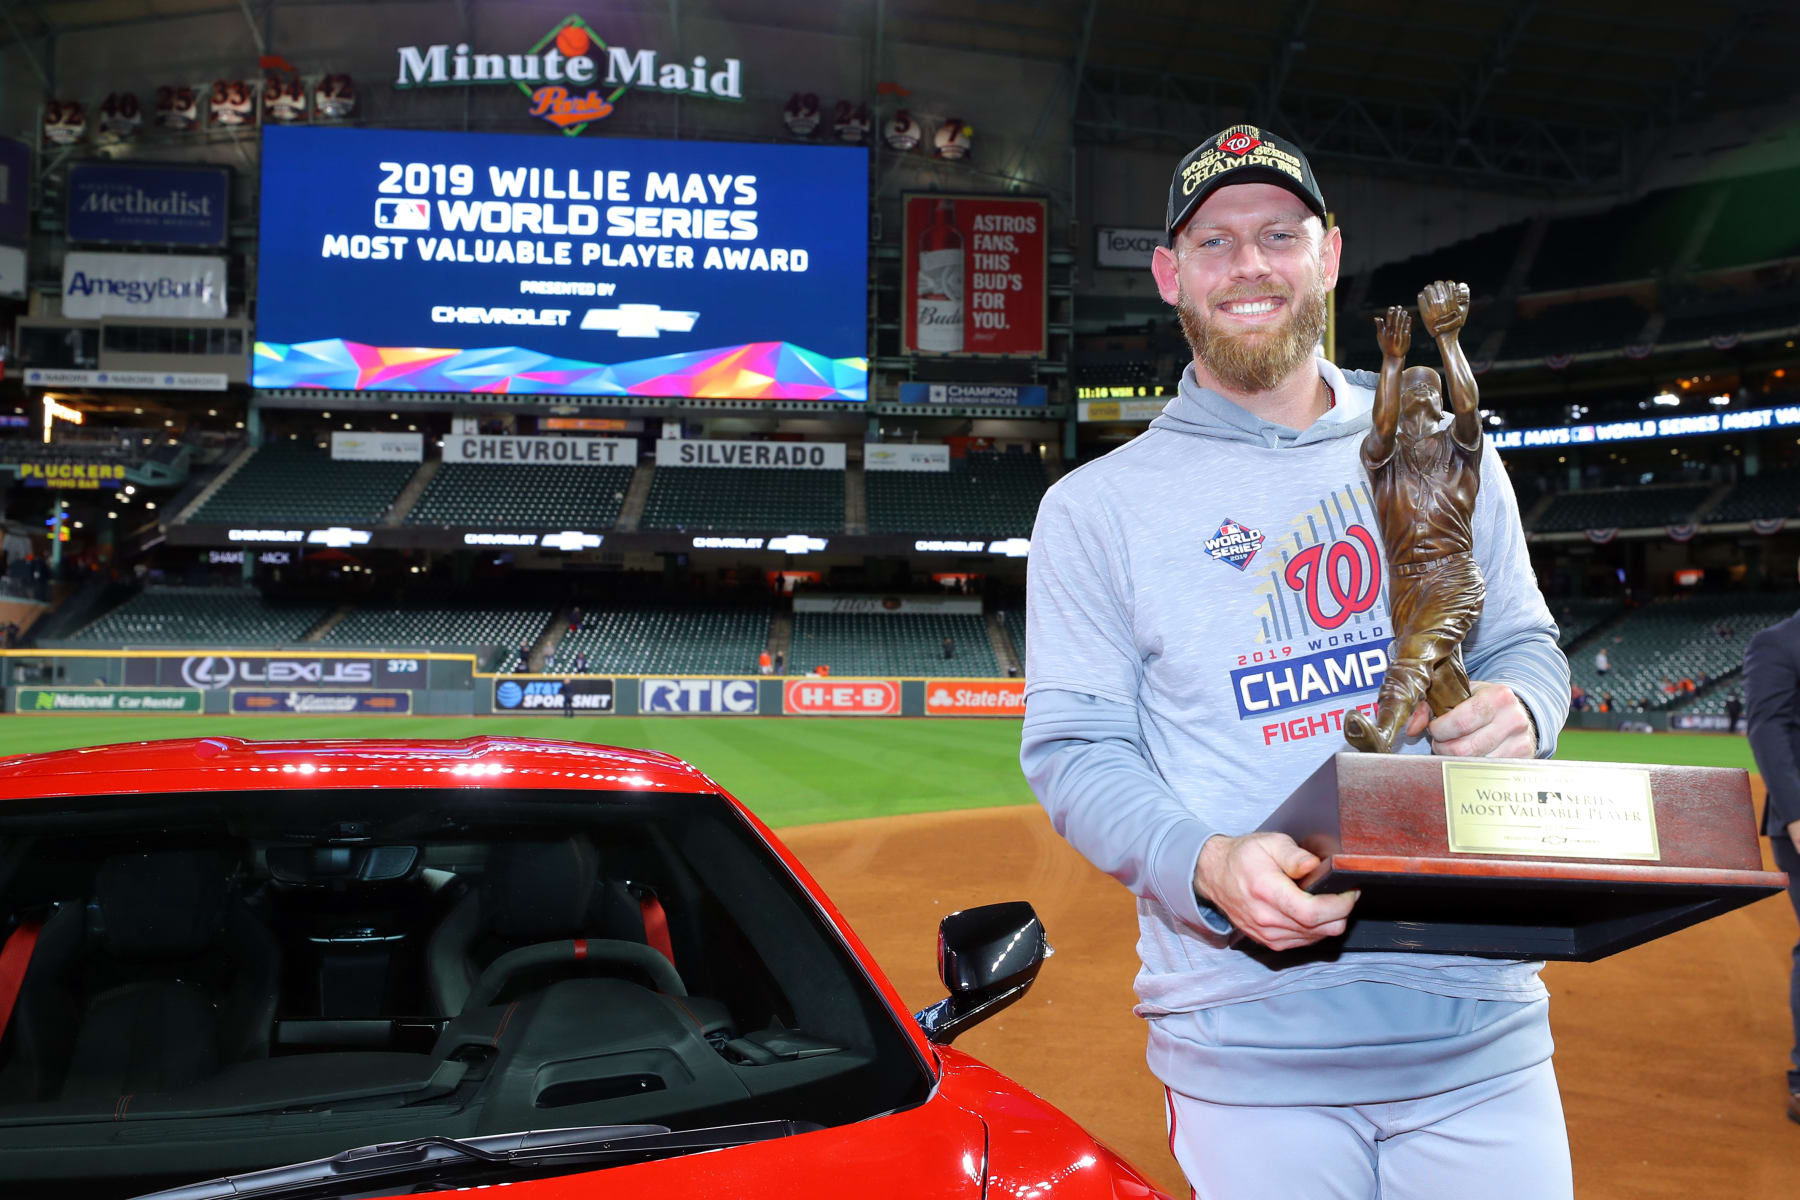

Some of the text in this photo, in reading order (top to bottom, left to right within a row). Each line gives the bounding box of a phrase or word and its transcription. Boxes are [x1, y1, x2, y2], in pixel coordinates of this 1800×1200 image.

[395, 43, 743, 98] Minute Maid
[211, 80, 248, 105] 33
[529, 86, 613, 126] Park
[944, 119, 964, 142] 7
[1181, 145, 1301, 180] WORLD SERIES
[378, 162, 758, 205] 2019 WILLIE MAYS
[1182, 154, 1304, 196] CHAMPIONS
[79, 189, 212, 217] Methodist
[438, 200, 758, 241] WORLD SERIES
[973, 214, 1037, 234] ASTROS
[322, 234, 809, 273] MOST VALUABLE PLAYER AWARD
[973, 234, 1019, 255] FANS,
[973, 254, 1011, 272] THIS
[520, 280, 616, 297] PRESENTED BY
[973, 273, 1023, 291] BUD'S
[973, 292, 1005, 310] FOR
[431, 305, 572, 327] CHEVROLET
[973, 311, 1011, 330] YOU.
[948, 385, 1018, 398] CHAMPION
[1524, 428, 1570, 446] MAYS
[1596, 420, 1657, 440] WORLD
[1658, 415, 1720, 435] SERIES
[1722, 409, 1773, 429] MOST
[461, 439, 619, 462] CHEVROLET
[680, 443, 826, 467] SILVERADO
[21, 463, 126, 479] PLUCKERS
[464, 533, 538, 545] CHEVROLET
[1204, 529, 1261, 550] WORLD
[1211, 540, 1263, 560] SERIES
[1230, 553, 1249, 561] 2019
[1238, 626, 1384, 666] 2019 WORLD
[240, 661, 372, 682] LEXUS
[387, 660, 418, 672] 373
[523, 681, 563, 696] AT&T
[644, 680, 754, 712] RTIC
[955, 689, 1025, 707] StateFar
[54, 693, 186, 709] National Car Rental
[522, 694, 611, 709] SPORSNET
[1262, 708, 1345, 746] FIGHT
